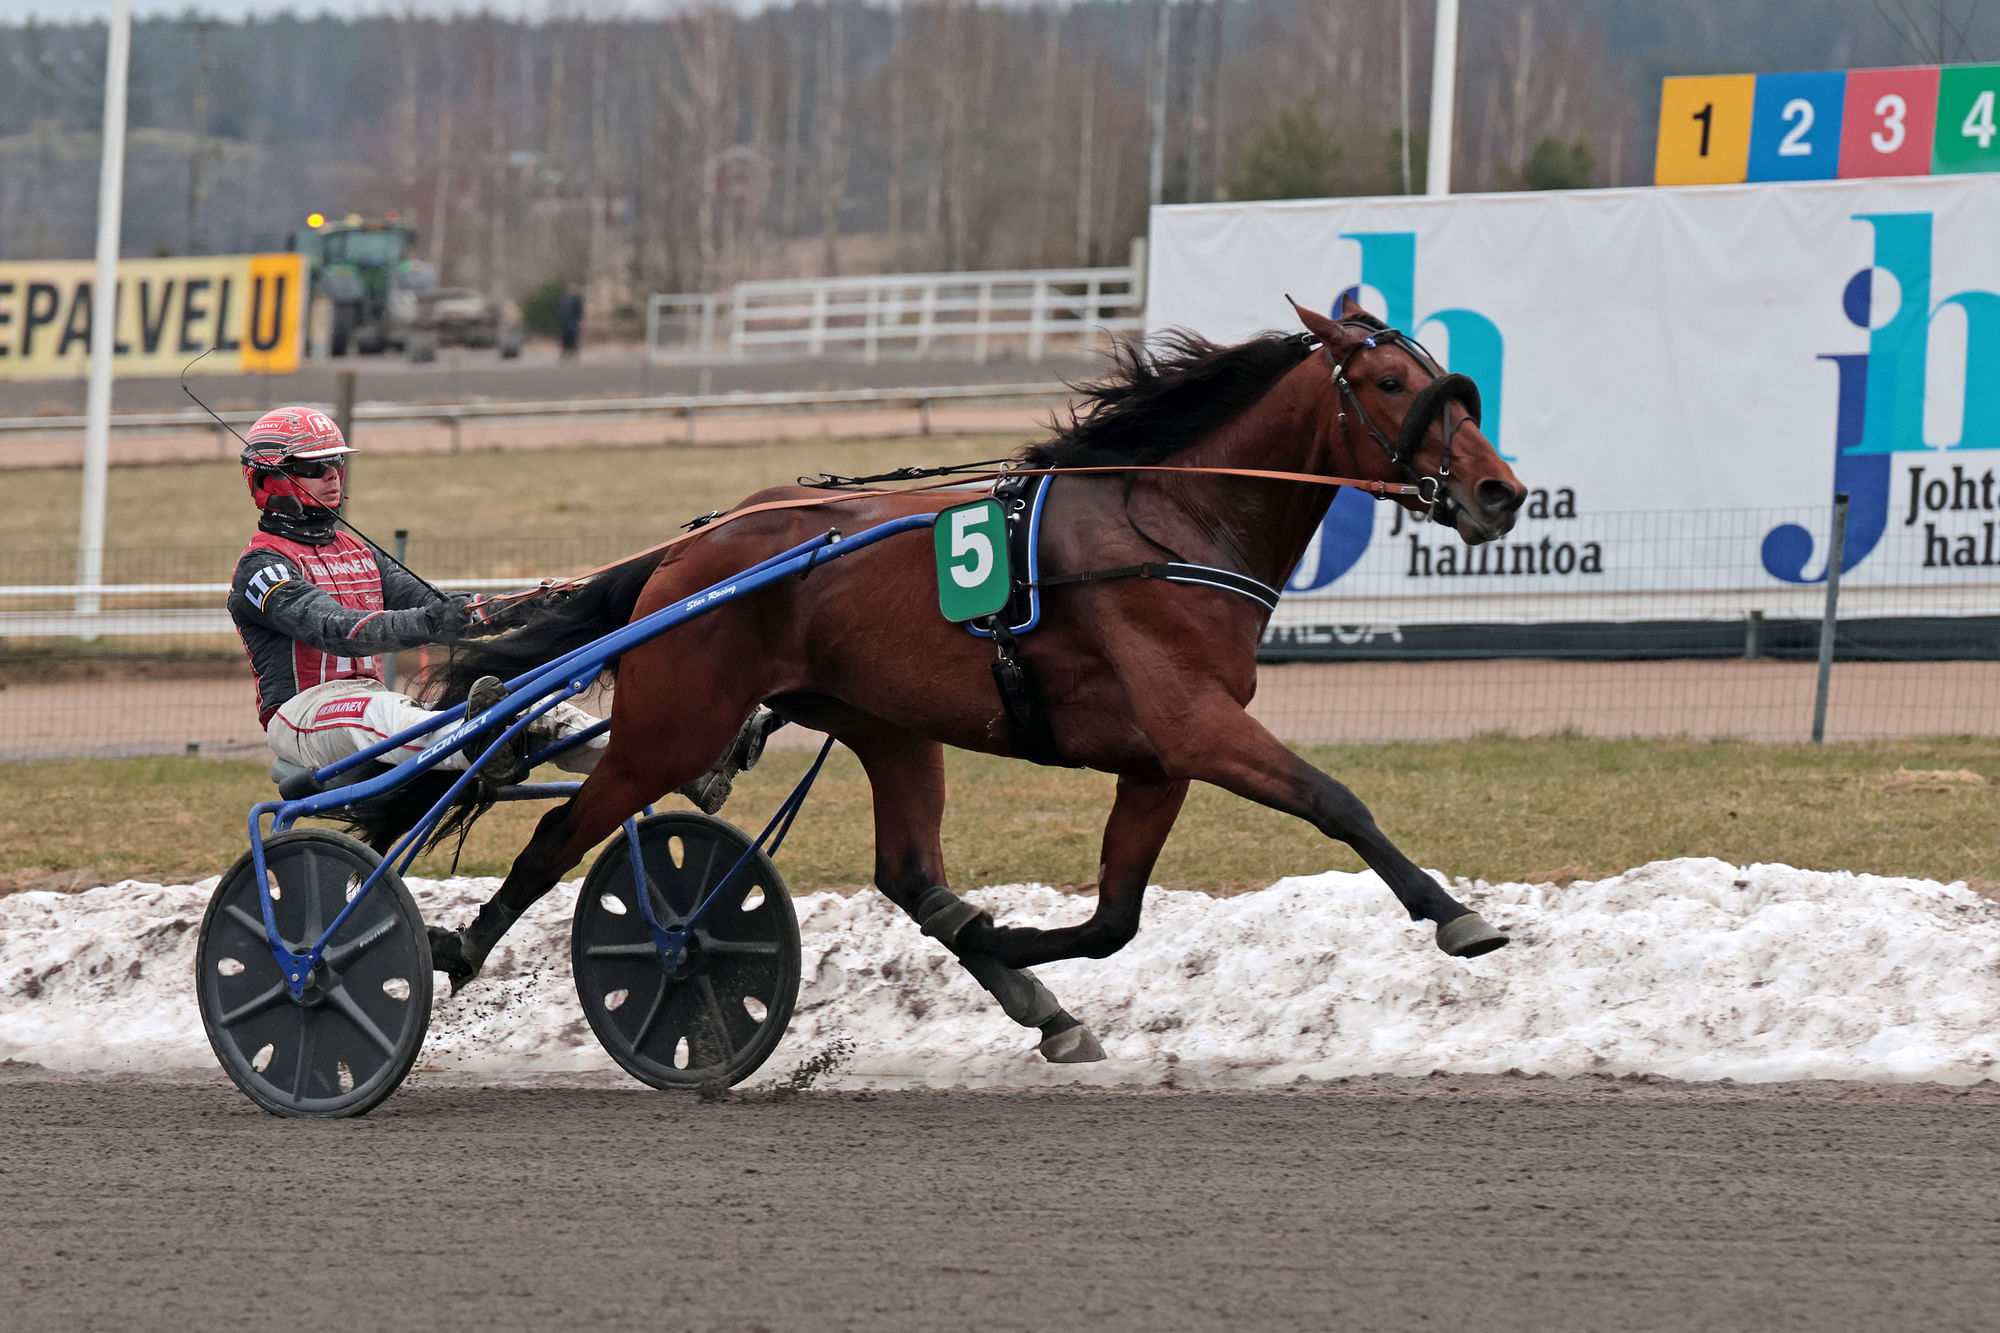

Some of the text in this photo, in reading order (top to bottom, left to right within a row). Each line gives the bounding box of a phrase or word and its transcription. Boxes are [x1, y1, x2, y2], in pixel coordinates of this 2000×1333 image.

[1692, 90, 1998, 157] 1 2 3 4
[1904, 466, 2000, 526] Joht
[950, 505, 994, 588] 5
[1407, 533, 1604, 577] hallintoa
[1922, 522, 2000, 567] hal
[244, 563, 290, 610] LTU
[686, 585, 736, 612] Star Racing
[416, 710, 493, 765] COMET
